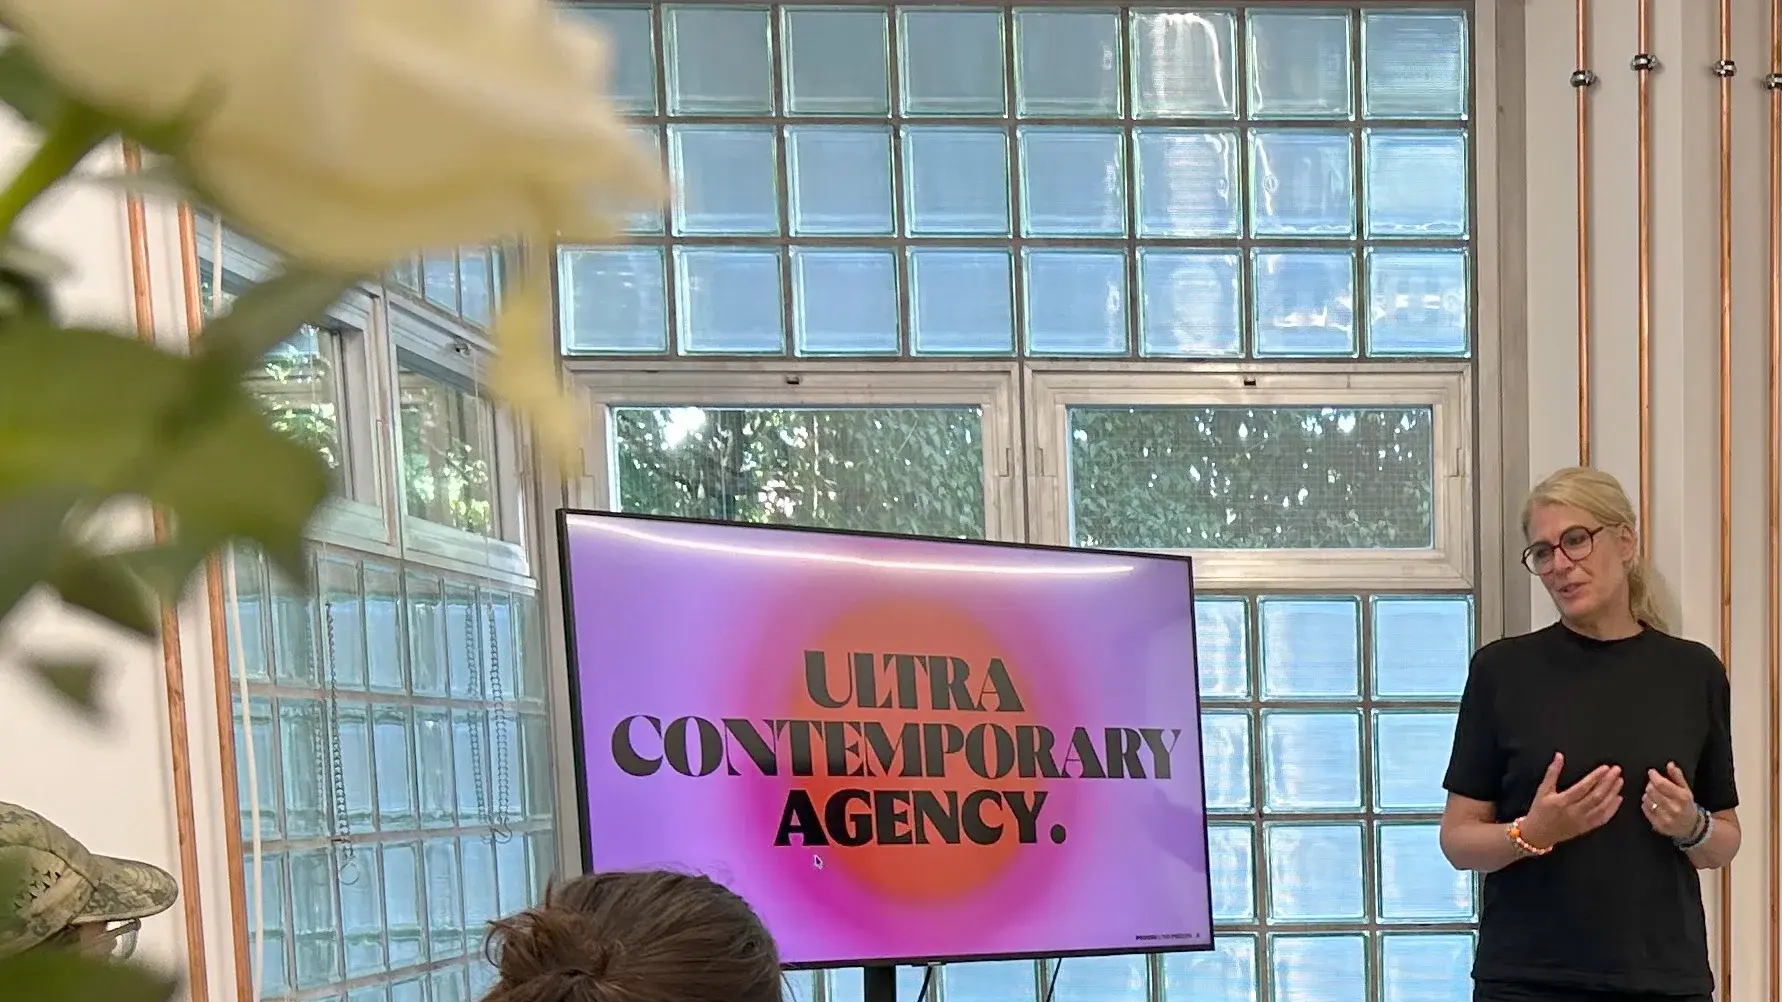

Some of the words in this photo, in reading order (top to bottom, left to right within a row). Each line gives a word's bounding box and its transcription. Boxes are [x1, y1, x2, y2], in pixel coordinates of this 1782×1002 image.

[803, 649, 1025, 713] ULTRA
[610, 714, 1182, 780] CONTEMPORARY
[773, 788, 1067, 847] AGENCY.
